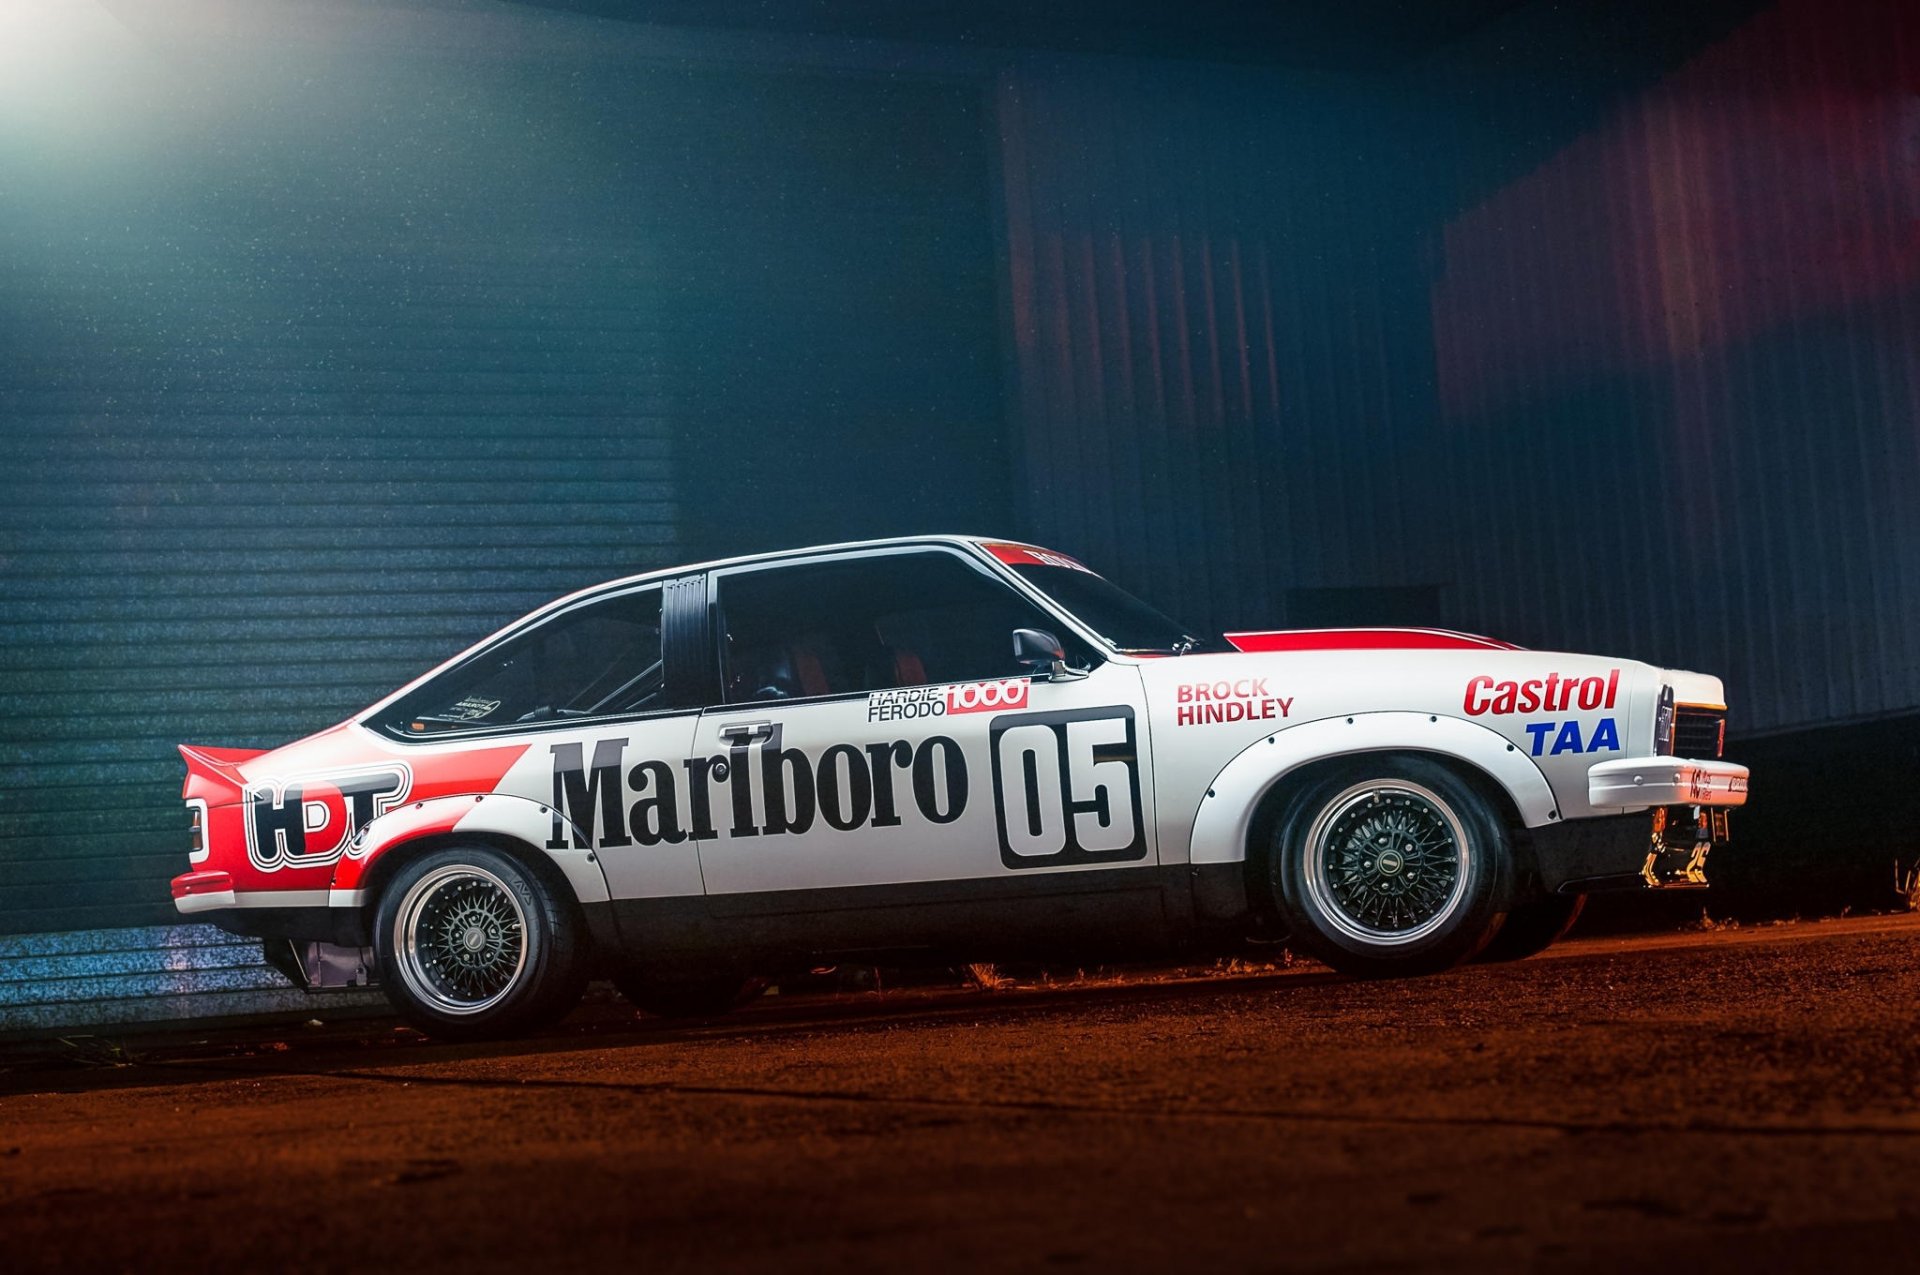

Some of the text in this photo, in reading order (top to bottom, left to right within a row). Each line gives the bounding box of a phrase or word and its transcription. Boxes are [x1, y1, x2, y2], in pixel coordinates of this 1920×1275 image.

[947, 679, 1026, 709] 1000
[1178, 678, 1269, 703] BROCK
[1463, 669, 1620, 716] Castrol
[868, 700, 946, 722] FERODO
[1178, 697, 1294, 726] HINDLEY
[1526, 718, 1620, 757] TAA
[546, 723, 969, 850] Marlboro
[999, 717, 1135, 857] 05
[248, 766, 407, 867] HDT
